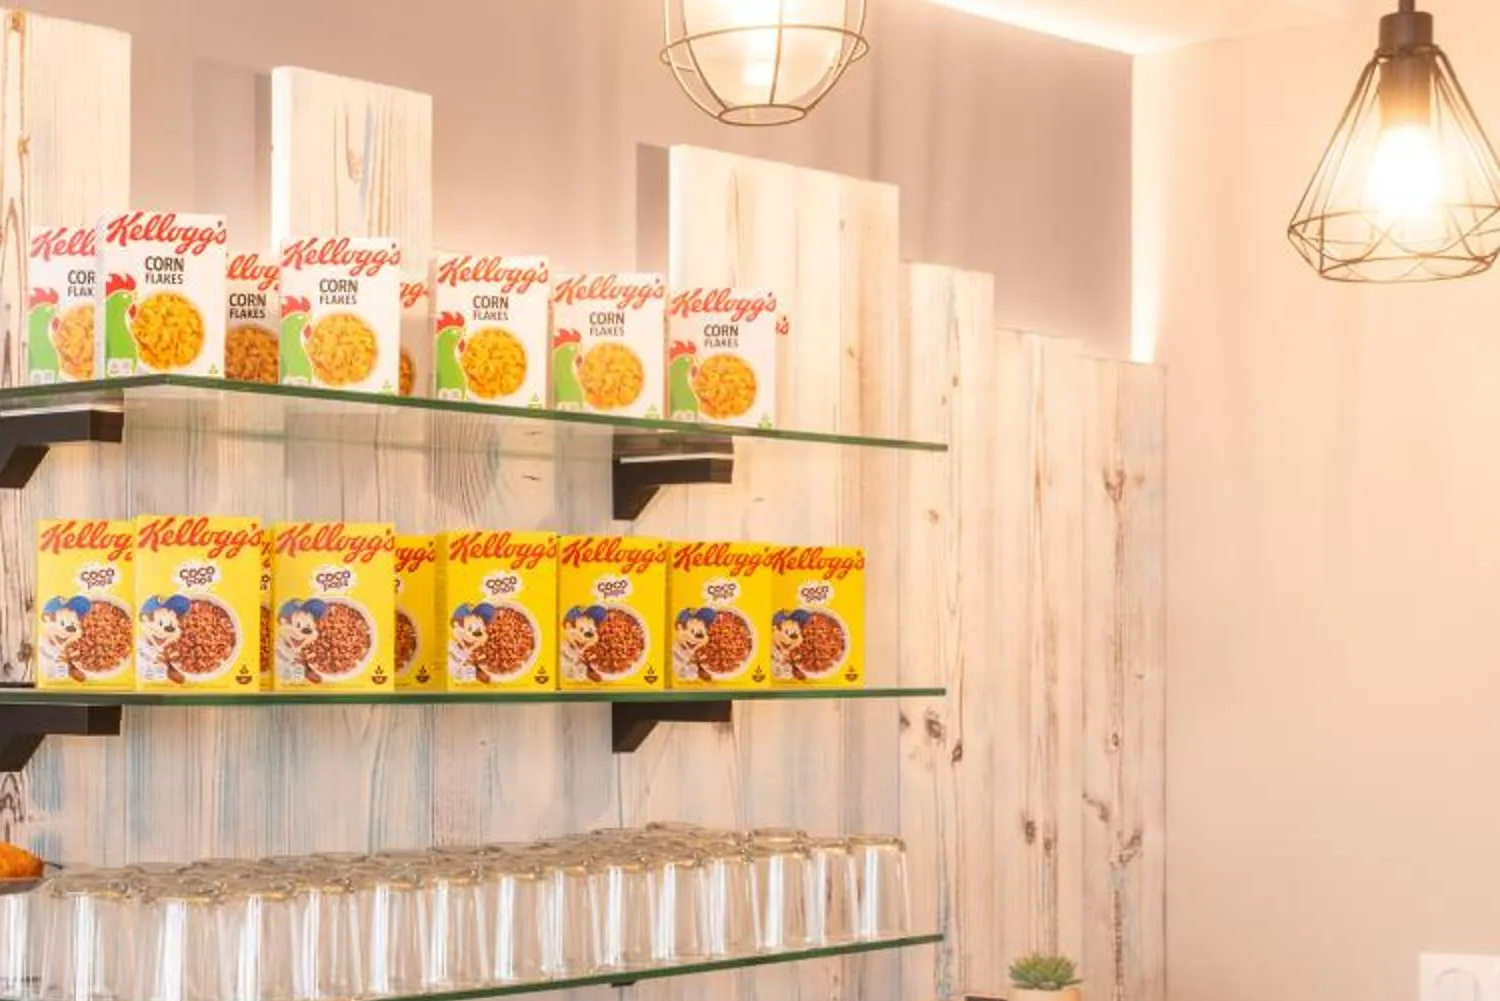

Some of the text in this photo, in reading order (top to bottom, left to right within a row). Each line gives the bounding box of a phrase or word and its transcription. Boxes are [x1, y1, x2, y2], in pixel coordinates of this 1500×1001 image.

[106, 212, 227, 256] Kellogg's
[144, 256, 185, 272] CORN
[282, 237, 400, 277] Kellogg's
[67, 270, 96, 285] COR
[144, 273, 184, 285] FLAKES
[437, 256, 549, 294] Kellogg's
[67, 286, 94, 298] FLAK
[318, 278, 359, 293] CORN
[554, 274, 665, 310] Kellogg's
[228, 293, 267, 307] CORN
[318, 294, 358, 305] FLAKES
[472, 295, 509, 309] CORN
[668, 287, 777, 322] Kellogg's
[228, 307, 266, 319] FLAKES
[472, 310, 509, 321] FLAKES
[589, 311, 625, 325] CORN
[589, 326, 625, 337] FLAKES
[703, 324, 739, 338] CORN
[703, 338, 739, 349] FLAKES
[41, 520, 132, 561] Kellog
[138, 516, 263, 559] Kellogg's
[276, 523, 396, 564] Kellogg's
[449, 531, 557, 570] Kellogg's
[561, 537, 668, 574] Kellogg's
[673, 542, 773, 577] Kellogg's
[771, 546, 865, 581] Kellogg's
[179, 566, 216, 579] COCO
